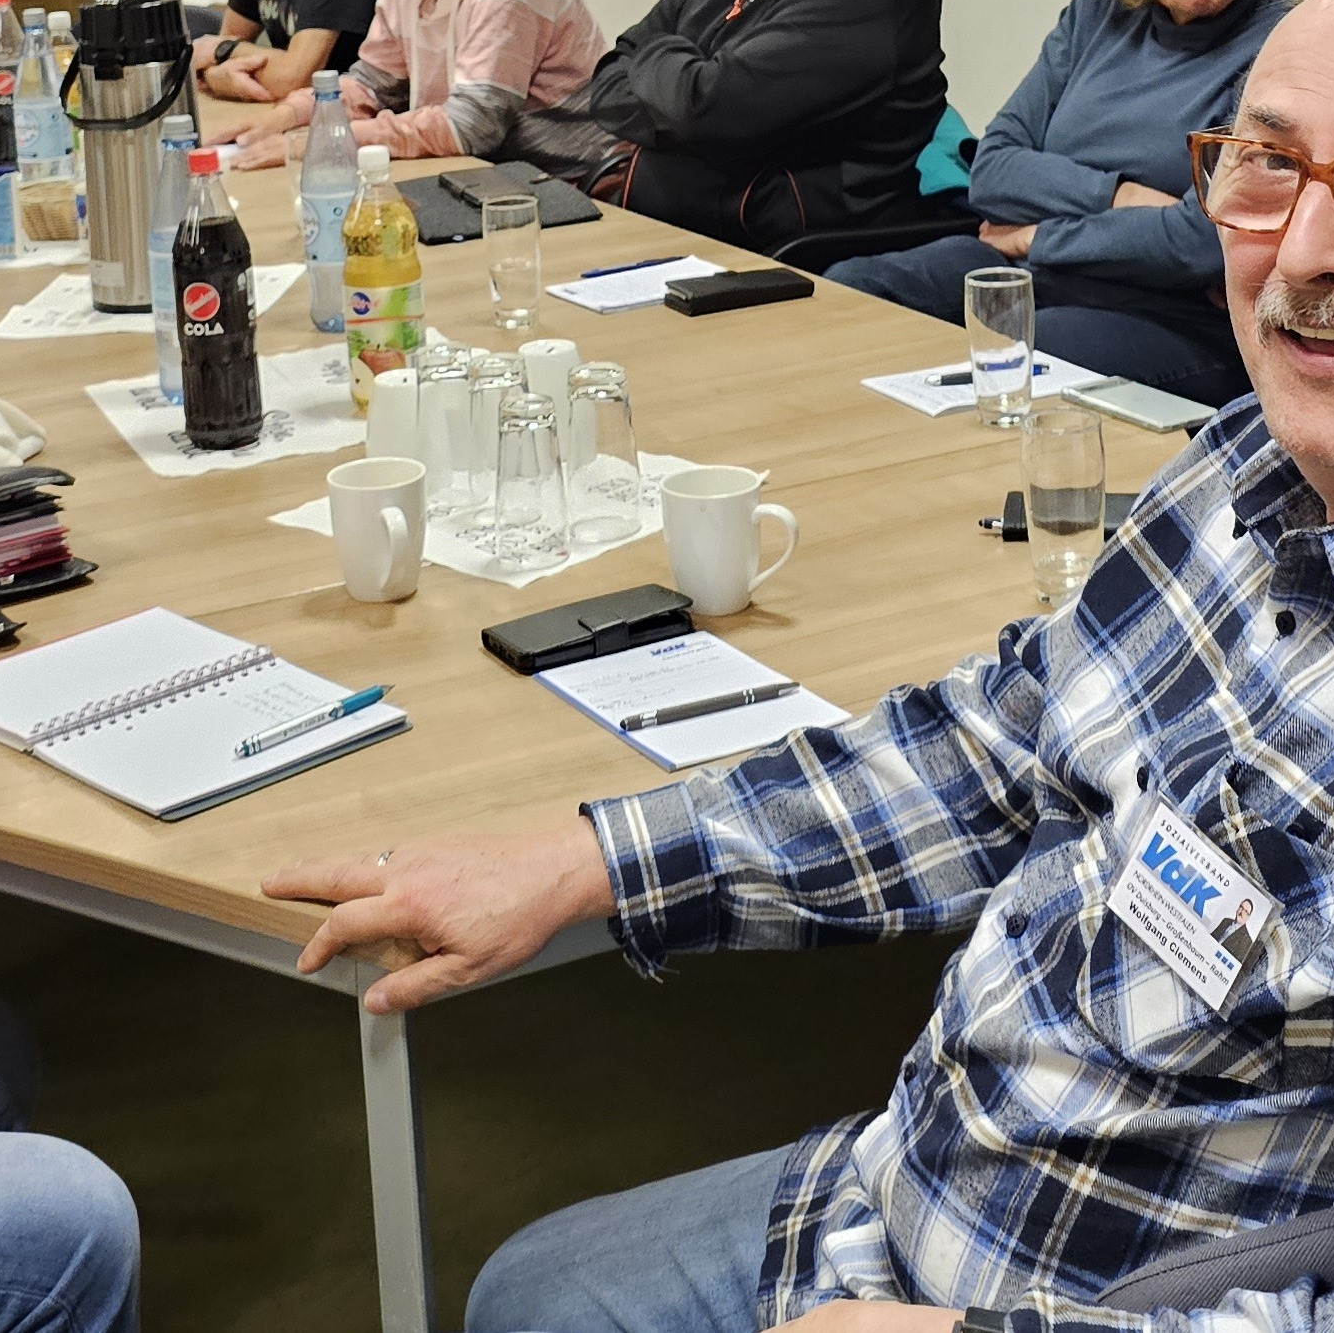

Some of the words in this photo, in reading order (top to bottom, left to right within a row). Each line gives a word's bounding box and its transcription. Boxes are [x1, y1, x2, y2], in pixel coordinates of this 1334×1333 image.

[183, 321, 225, 337] COLA
[1141, 831, 1223, 919] VdK
[1161, 819, 1230, 887] SOZIALVERBAND
[1129, 901, 1168, 947] Wolfgang
[1169, 941, 1208, 985] Clemens
[1135, 892, 1162, 921] Duisburg
[1166, 922, 1205, 963] Großenbaum
[1209, 962, 1230, 986] Rahm
